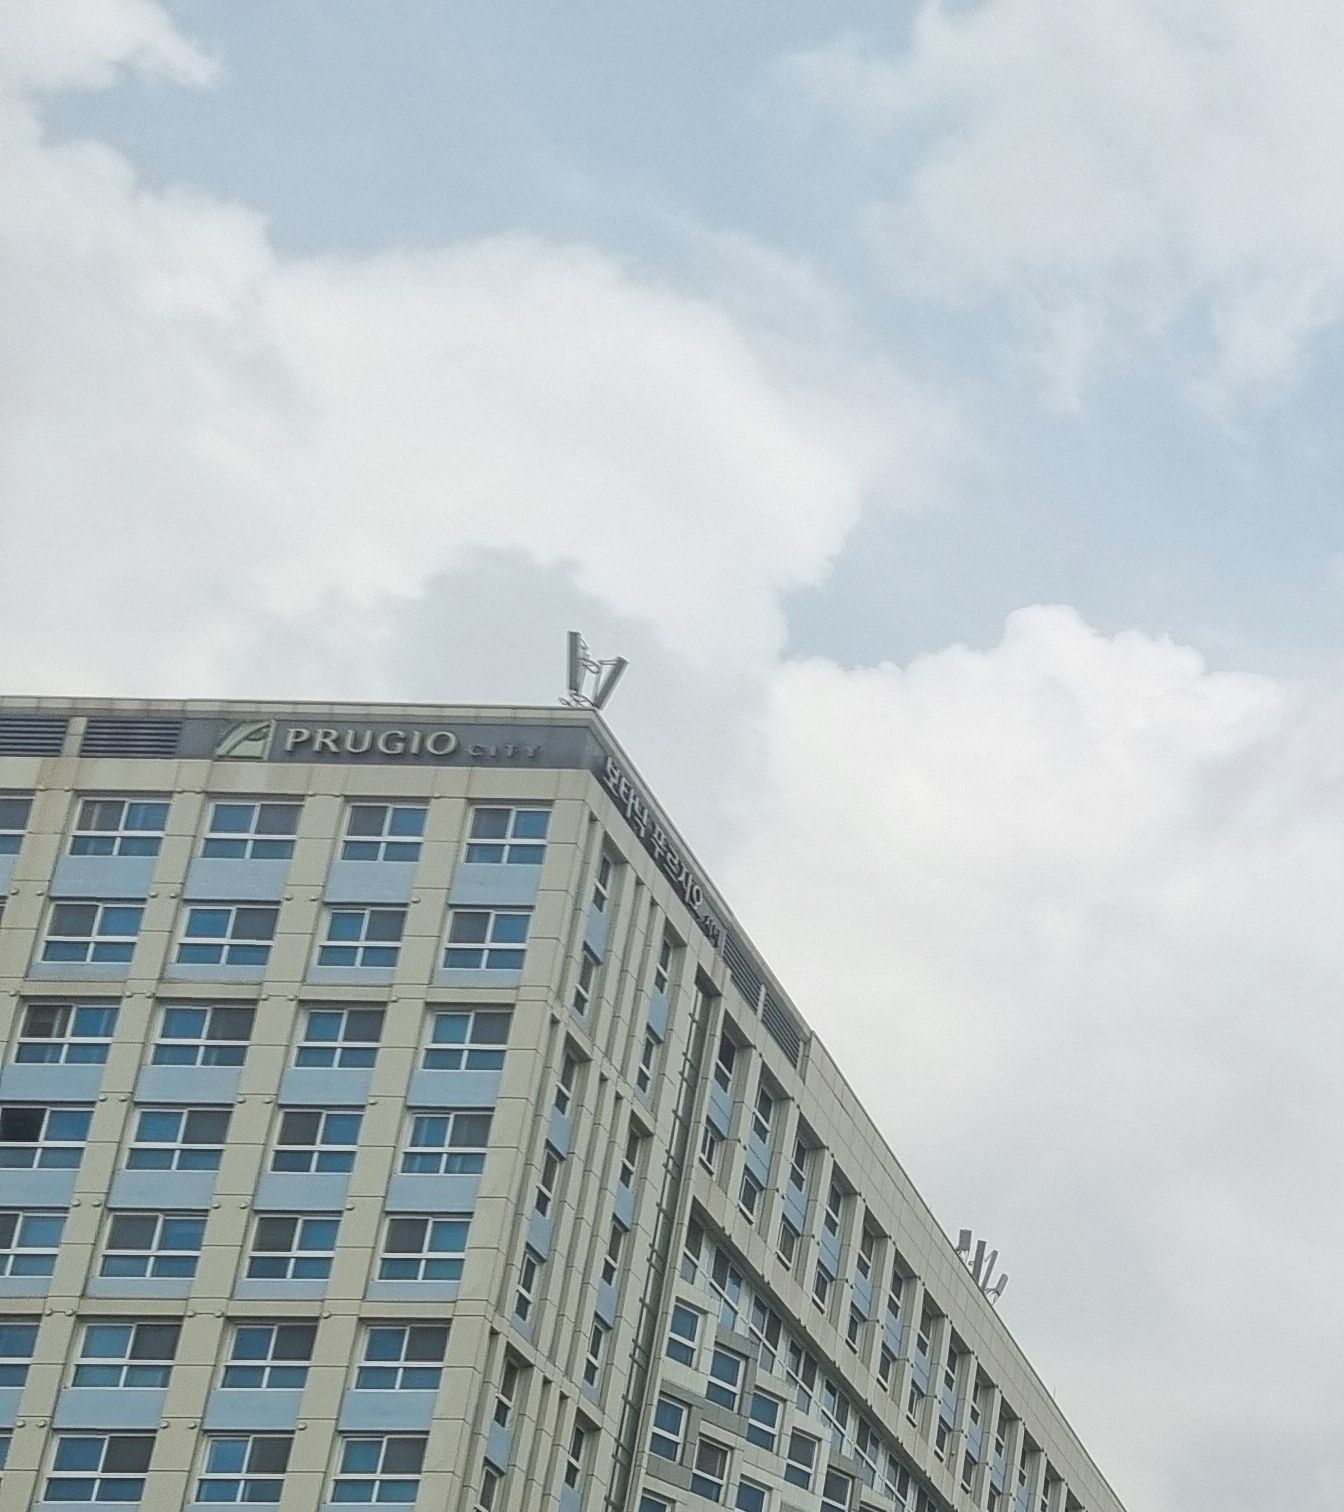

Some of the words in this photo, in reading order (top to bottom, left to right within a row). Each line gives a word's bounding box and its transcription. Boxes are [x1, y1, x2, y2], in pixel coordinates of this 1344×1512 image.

[283, 727, 458, 756] PRUGIO
[468, 743, 542, 759] CITY
[602, 756, 649, 839] 보타닉
